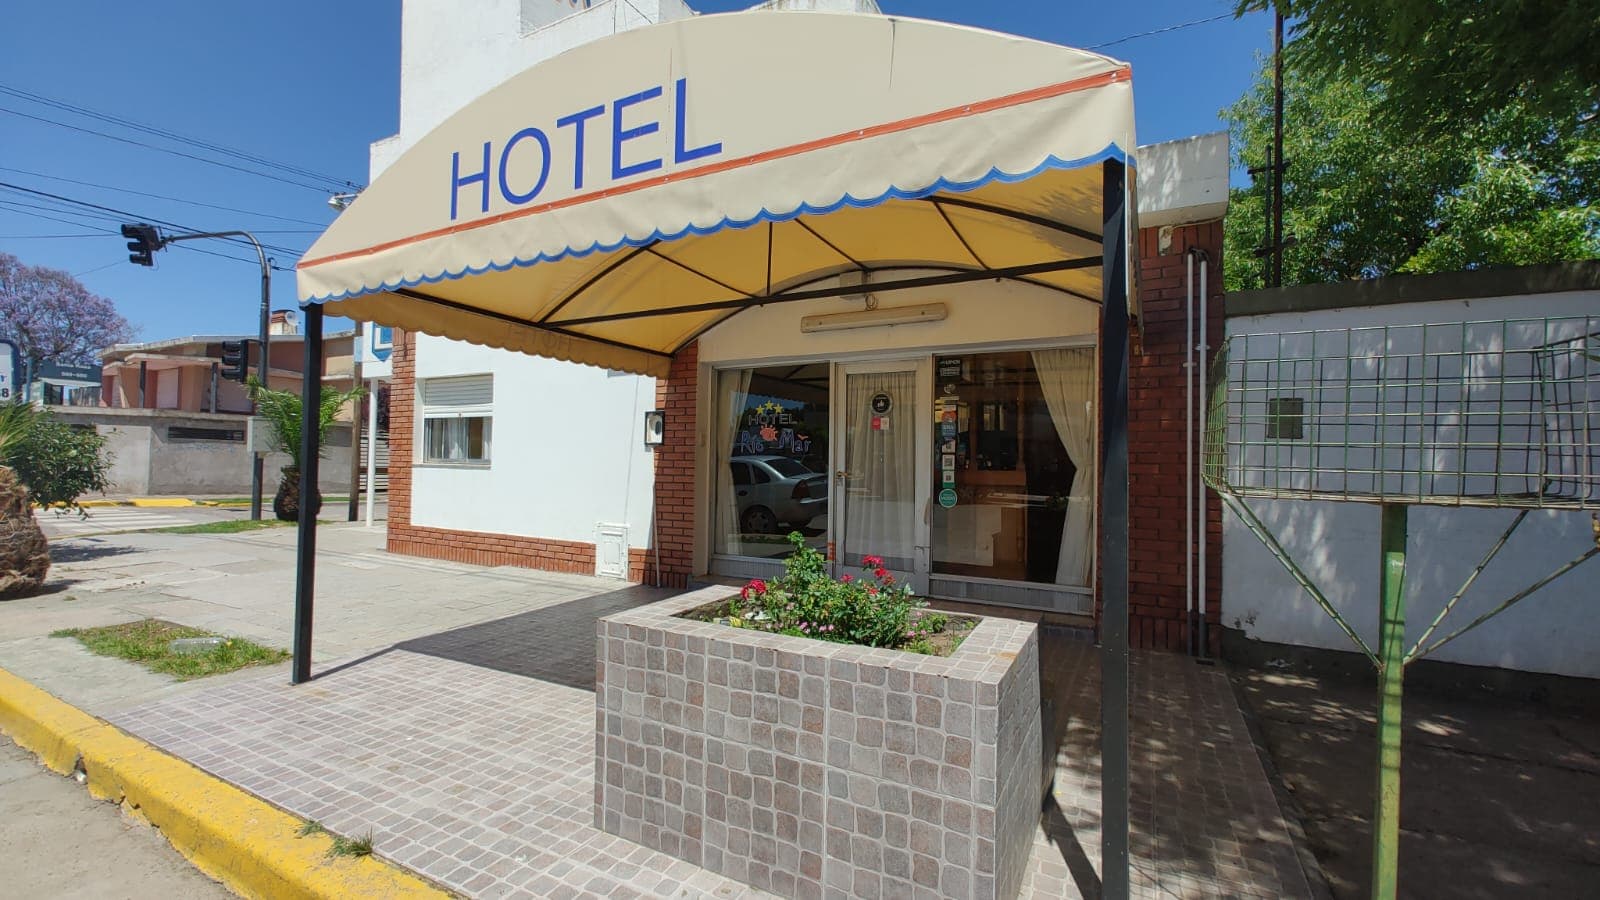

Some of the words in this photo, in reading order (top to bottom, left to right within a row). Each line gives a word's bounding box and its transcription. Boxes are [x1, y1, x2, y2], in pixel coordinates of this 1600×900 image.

[450, 77, 722, 220] HOTEL
[747, 413, 798, 425] HOTEL
[769, 428, 812, 454] Mar
